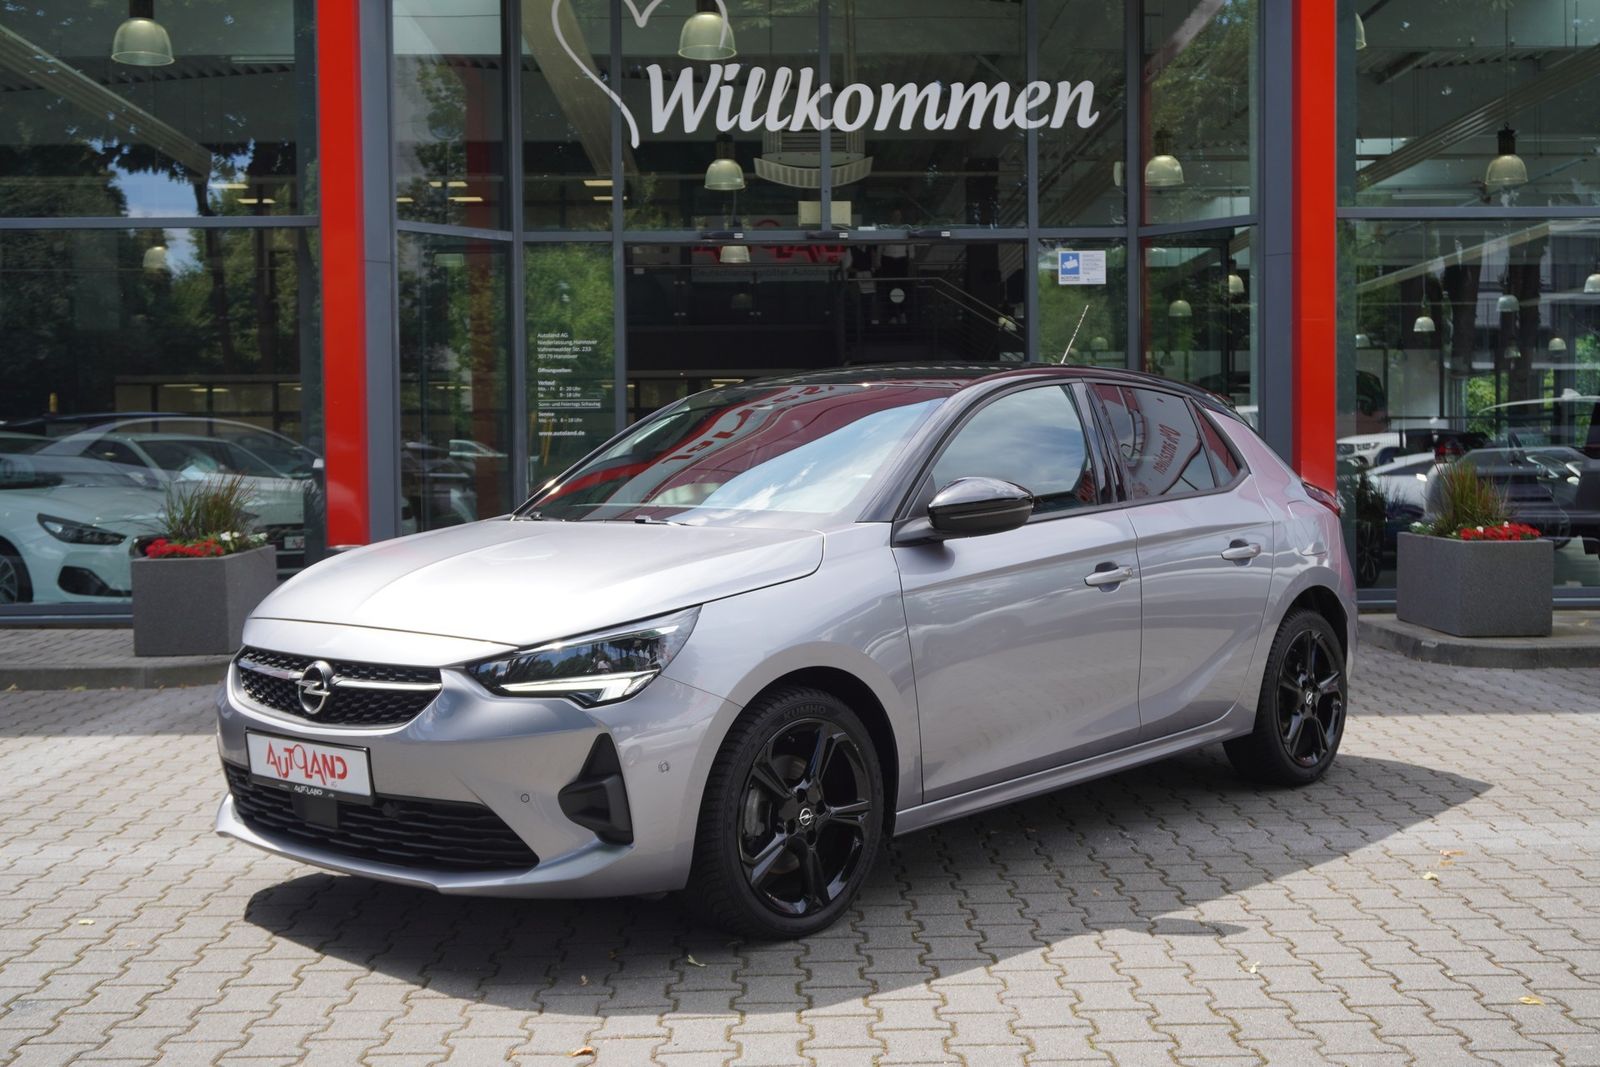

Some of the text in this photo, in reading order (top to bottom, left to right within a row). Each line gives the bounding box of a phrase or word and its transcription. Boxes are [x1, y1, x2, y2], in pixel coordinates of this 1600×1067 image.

[645, 63, 1099, 134] Willkommen
[783, 704, 826, 718] KUMHO
[266, 739, 348, 786] AUTOLAND
